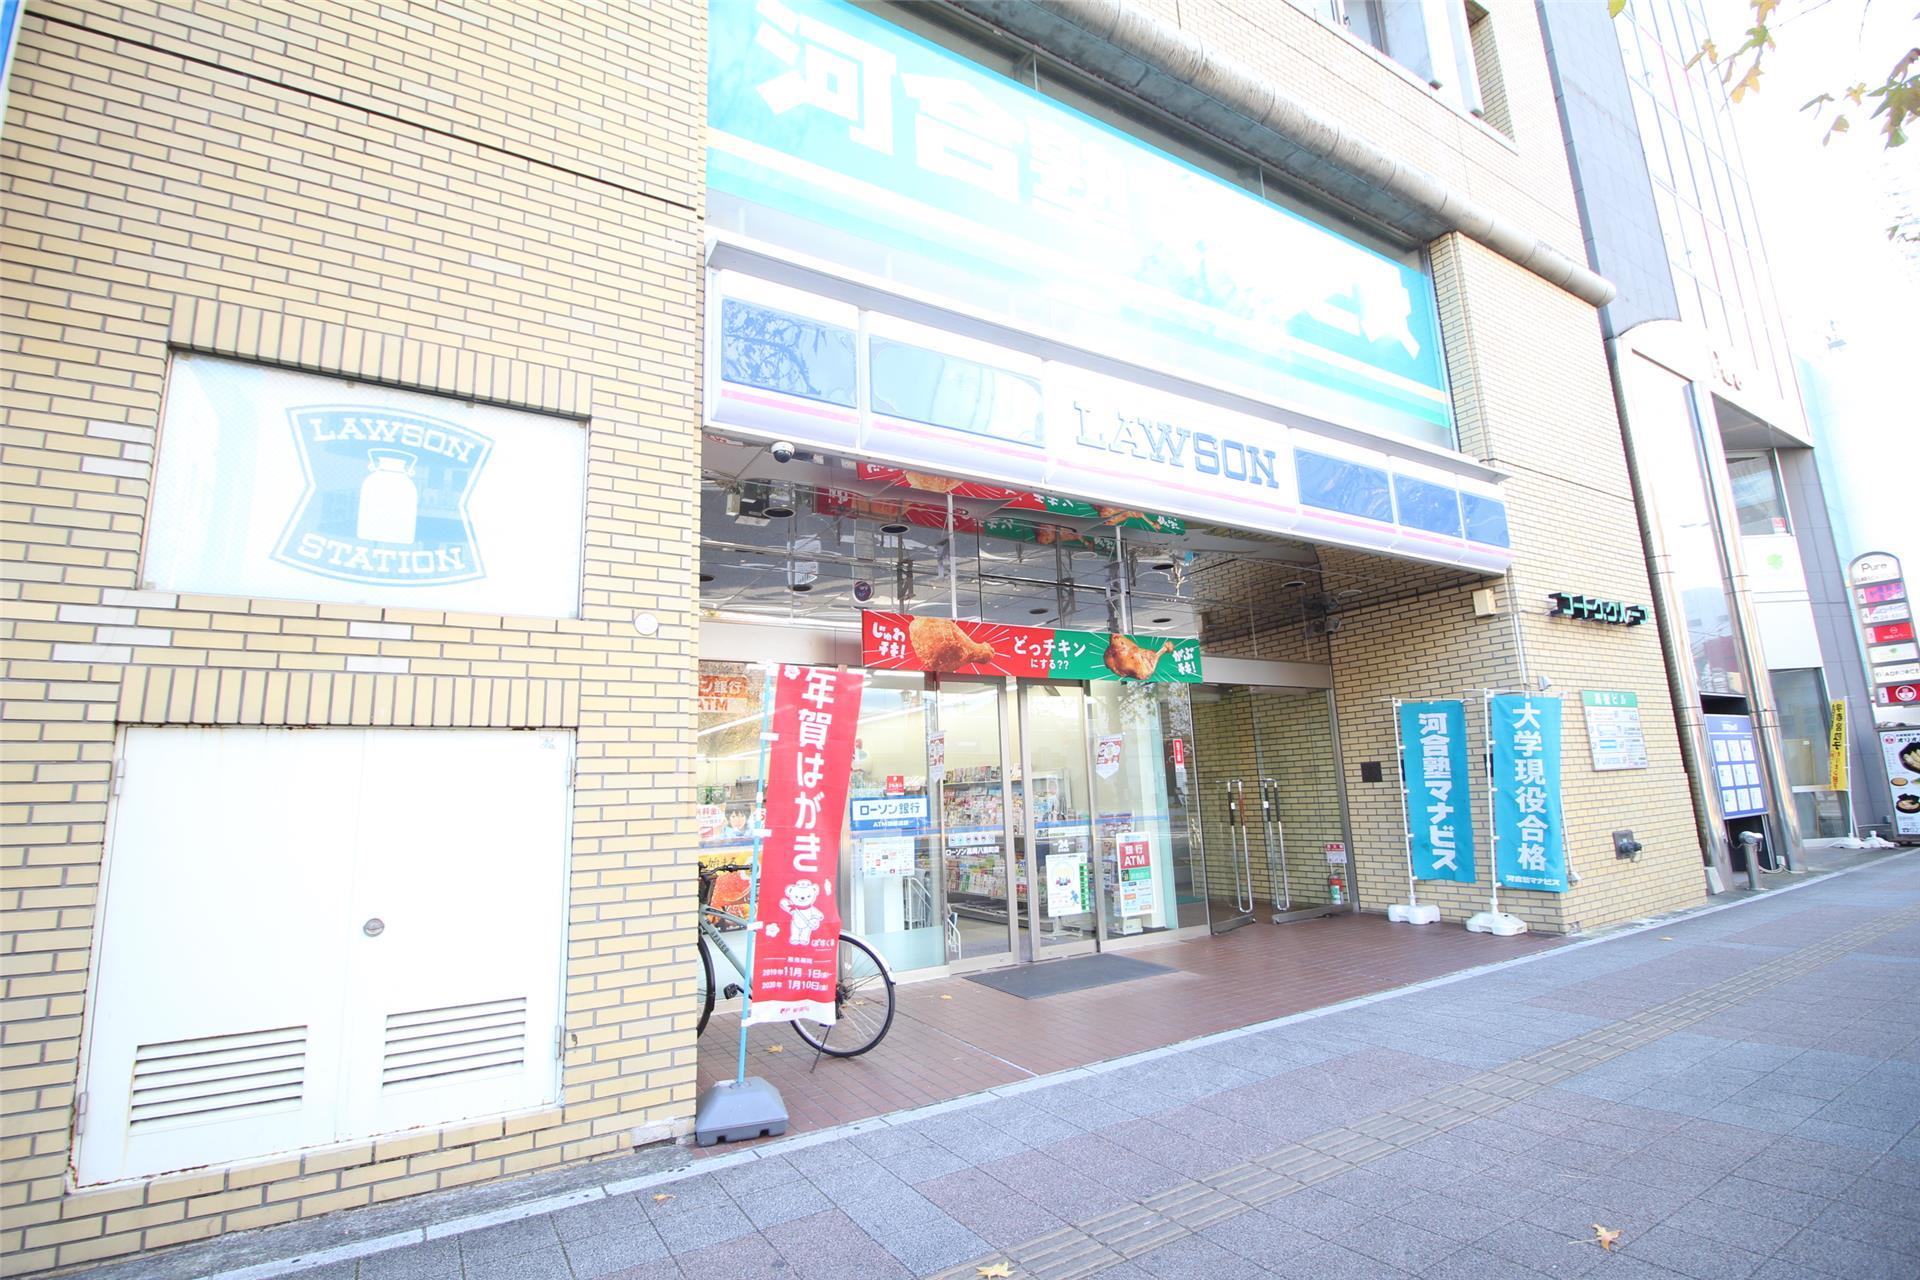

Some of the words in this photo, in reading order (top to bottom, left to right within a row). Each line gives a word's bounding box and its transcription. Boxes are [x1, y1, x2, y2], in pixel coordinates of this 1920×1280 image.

[308, 416, 476, 463] LAWSON
[1073, 401, 1279, 488] LAWSON
[296, 532, 465, 575] STATION
[1013, 635, 1087, 659] どっチキン
[793, 671, 837, 873] 年賀はがき
[1418, 712, 1459, 872] 河合塾マナビス
[1512, 703, 1549, 871] 大学現役合格
[859, 802, 921, 816] ローソン銀行
[1124, 844, 1144, 854] 銀行
[1124, 855, 1146, 867] ATM
